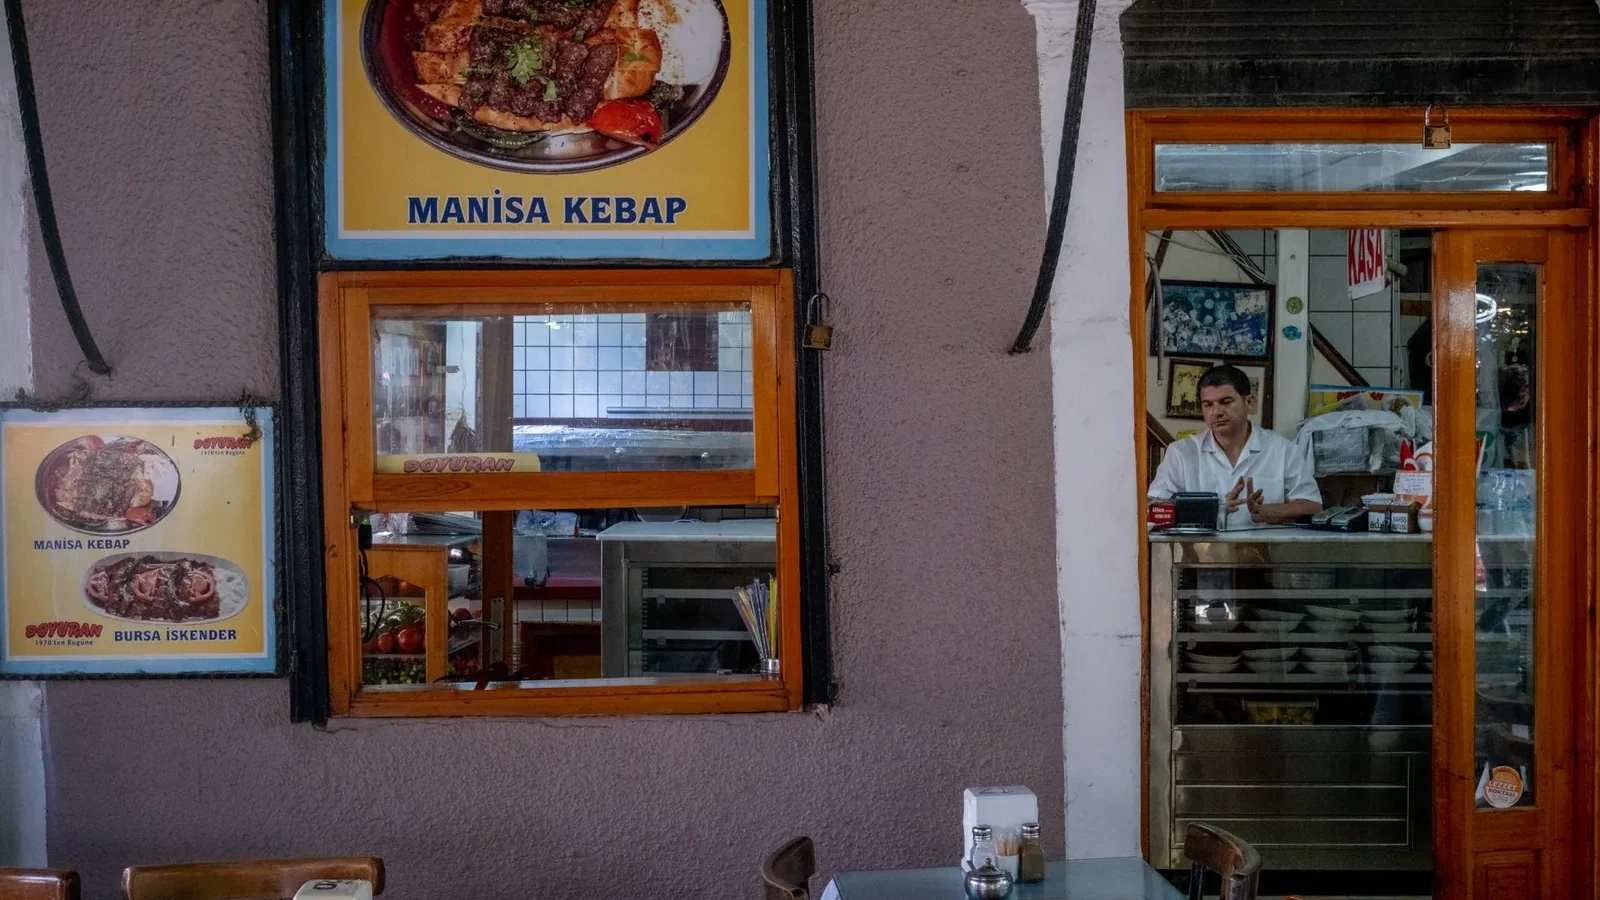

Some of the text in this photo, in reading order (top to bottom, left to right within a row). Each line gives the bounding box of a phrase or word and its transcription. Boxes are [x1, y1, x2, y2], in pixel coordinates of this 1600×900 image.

[407, 188, 688, 225] MANİSA KEBAP
[1348, 229, 1384, 287] KASA
[193, 436, 252, 449] DOYURAN
[403, 456, 515, 473] DOYURAN
[33, 537, 131, 550] MANİSA KEBAP
[25, 621, 103, 638] DOYURAN
[114, 627, 237, 642] BURSA İSKENDER
